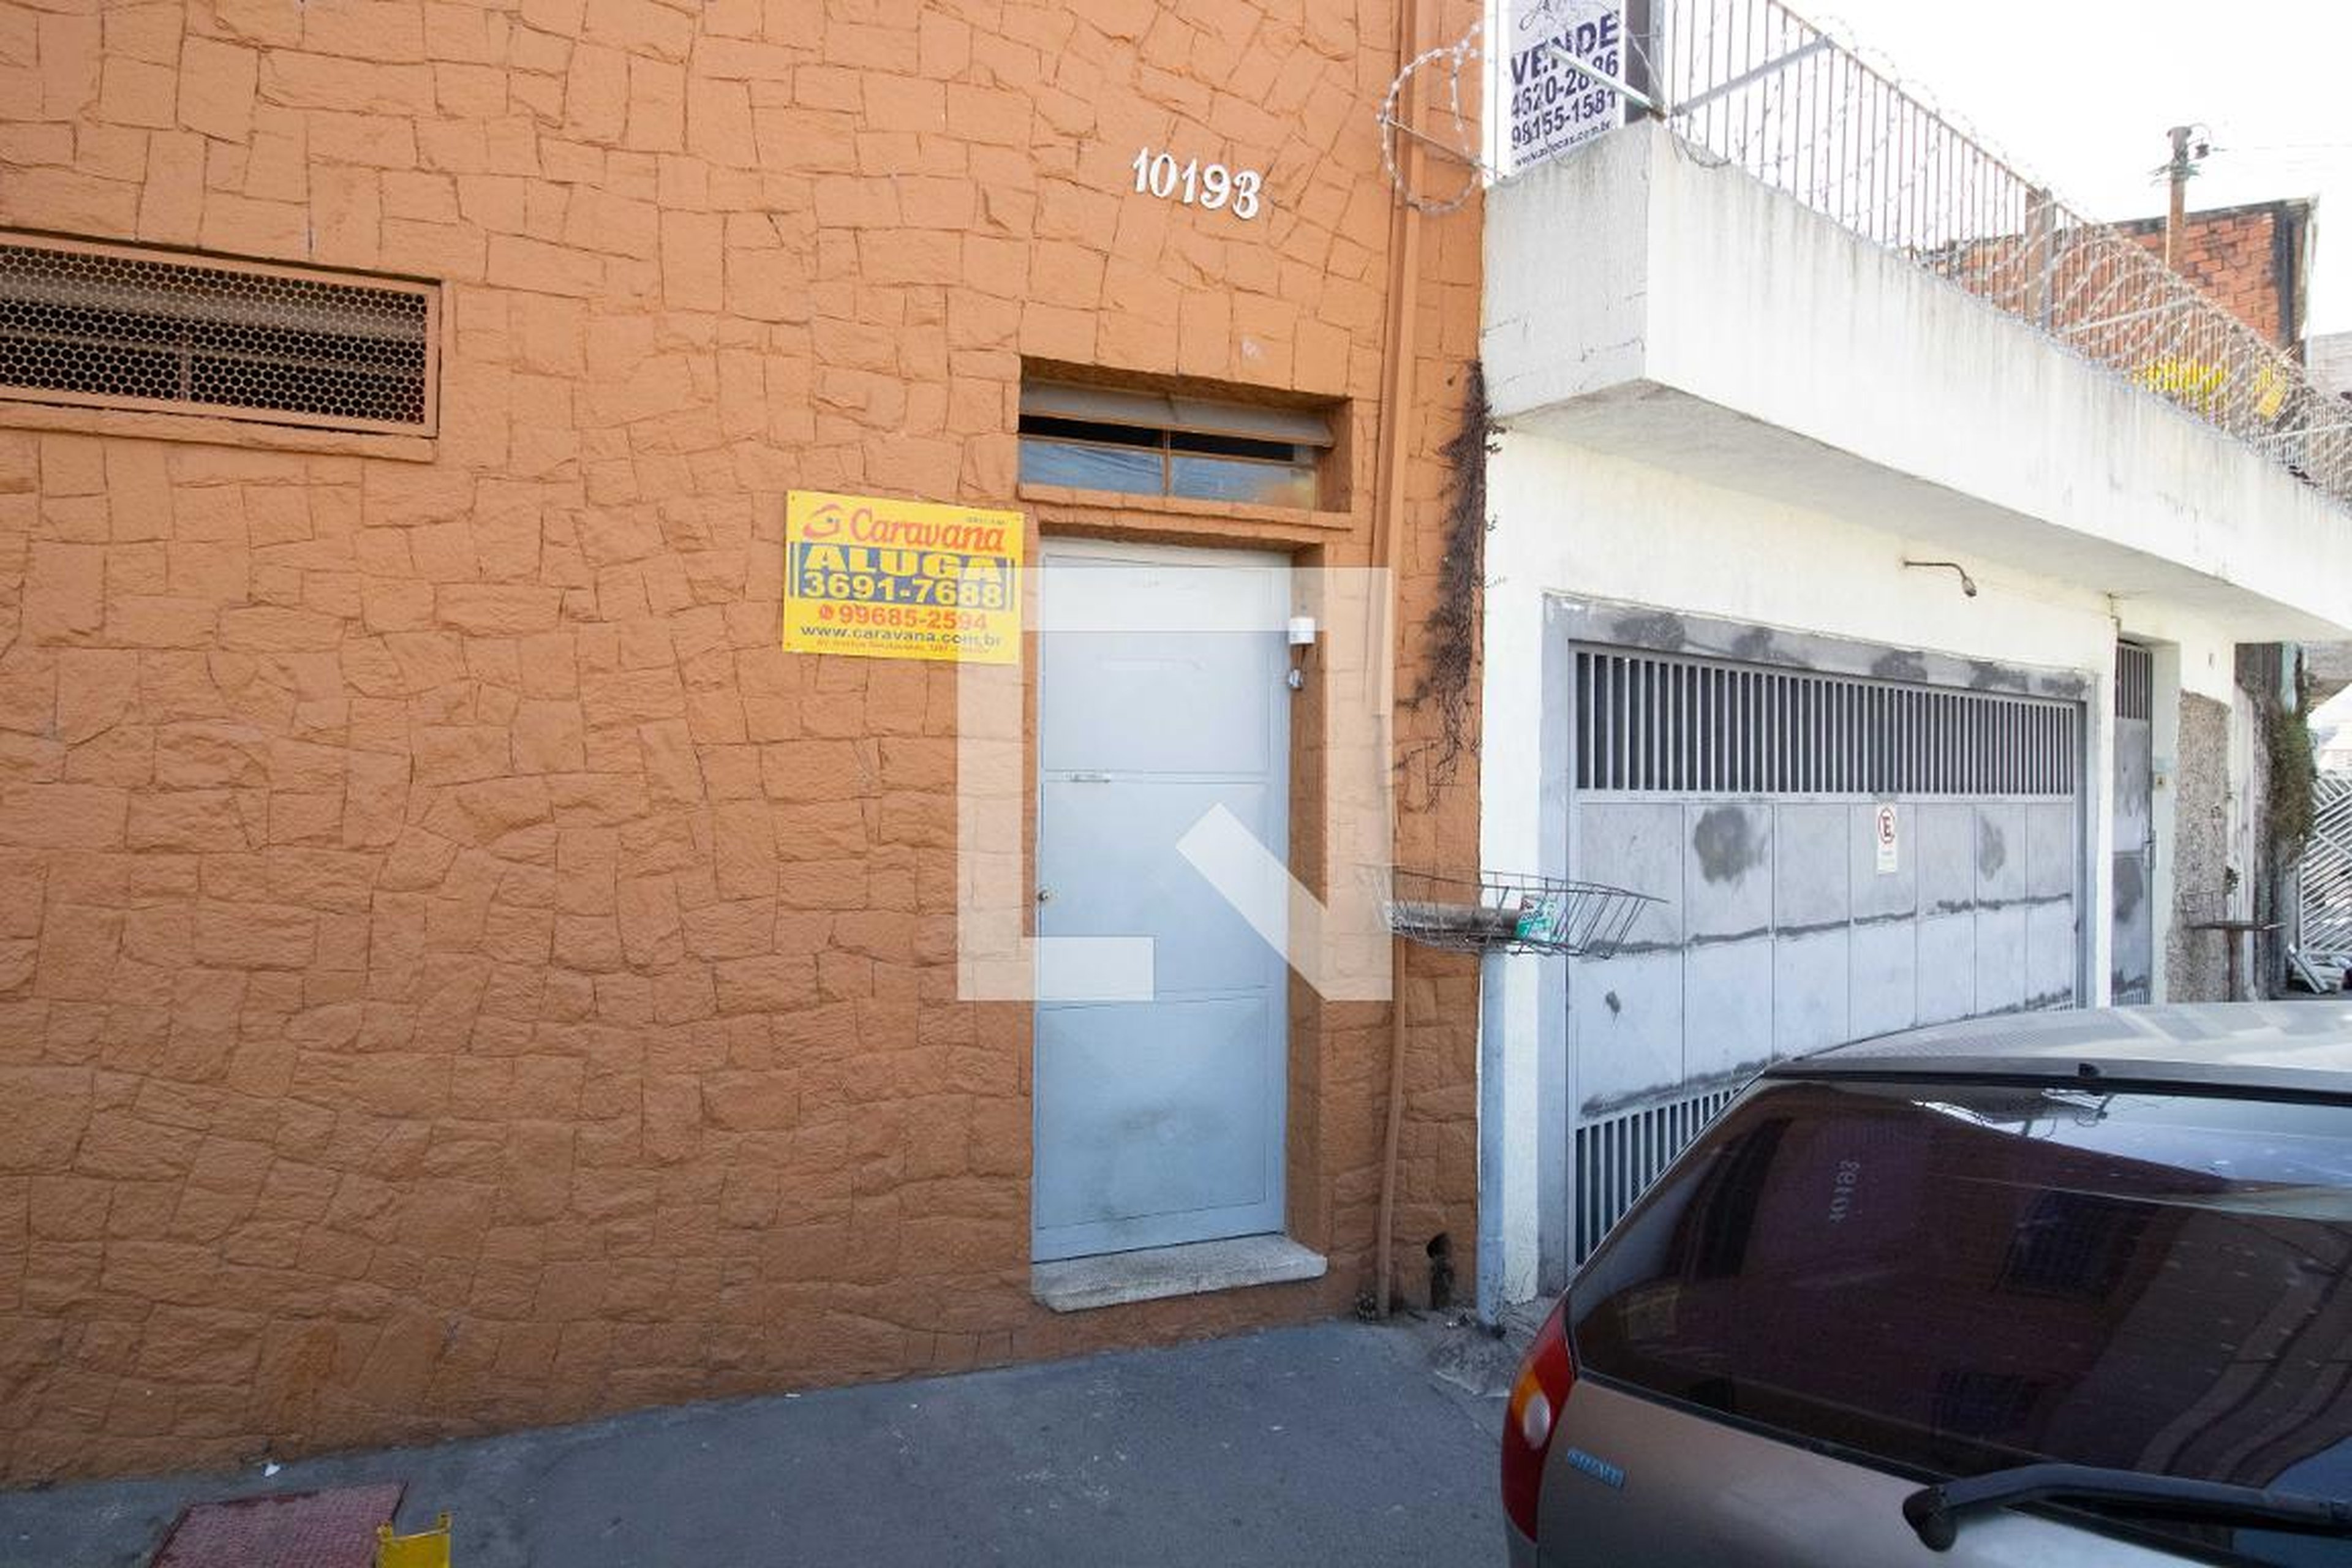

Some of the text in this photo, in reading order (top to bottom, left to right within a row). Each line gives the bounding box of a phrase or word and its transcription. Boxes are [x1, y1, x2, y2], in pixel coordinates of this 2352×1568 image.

[1512, 11, 1619, 85] VENDE
[1512, 88, 1617, 149] 98155-1581
[850, 506, 1006, 553] Caravana
[803, 544, 1003, 583] ALUGA
[800, 625, 1001, 647] www.caravana.com.br
